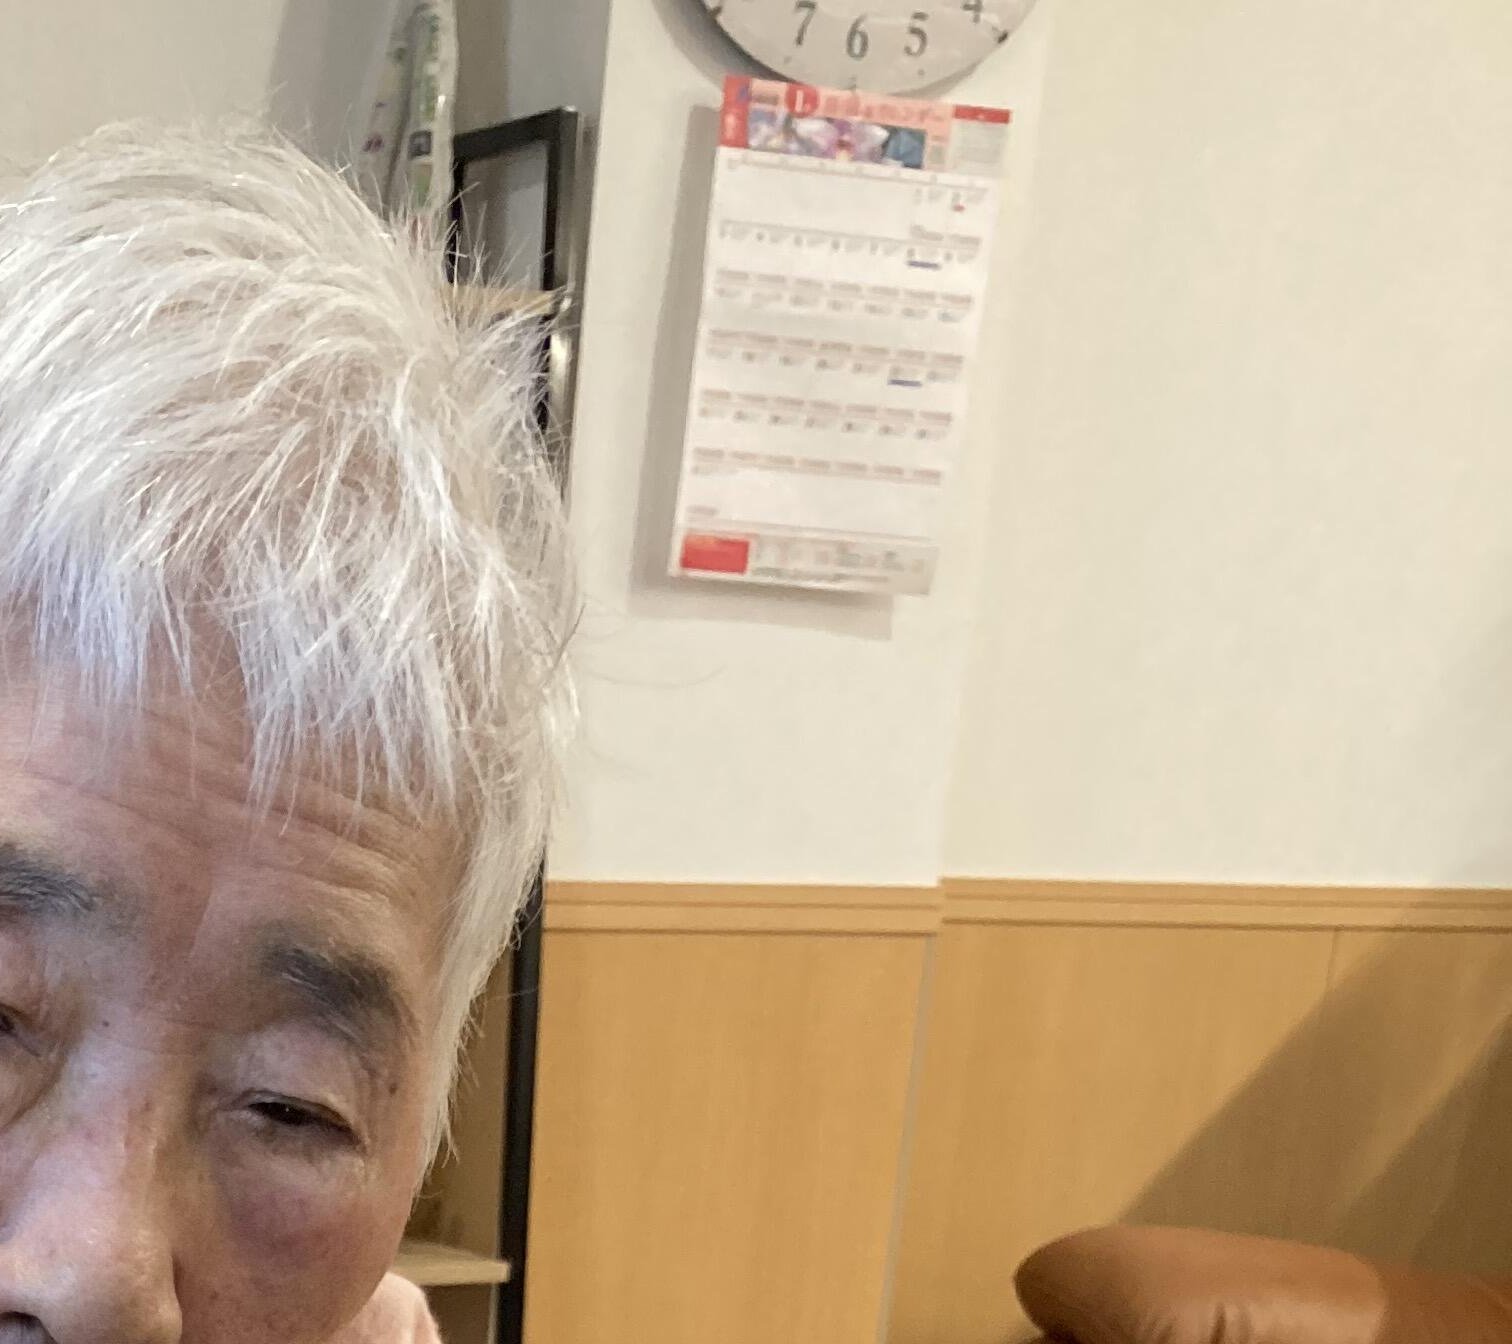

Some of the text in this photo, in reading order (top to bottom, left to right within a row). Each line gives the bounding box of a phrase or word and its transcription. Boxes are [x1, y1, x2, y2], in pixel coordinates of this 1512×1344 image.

[794, 0, 818, 46] 7
[846, 14, 870, 60] 6
[903, 11, 929, 57] 5
